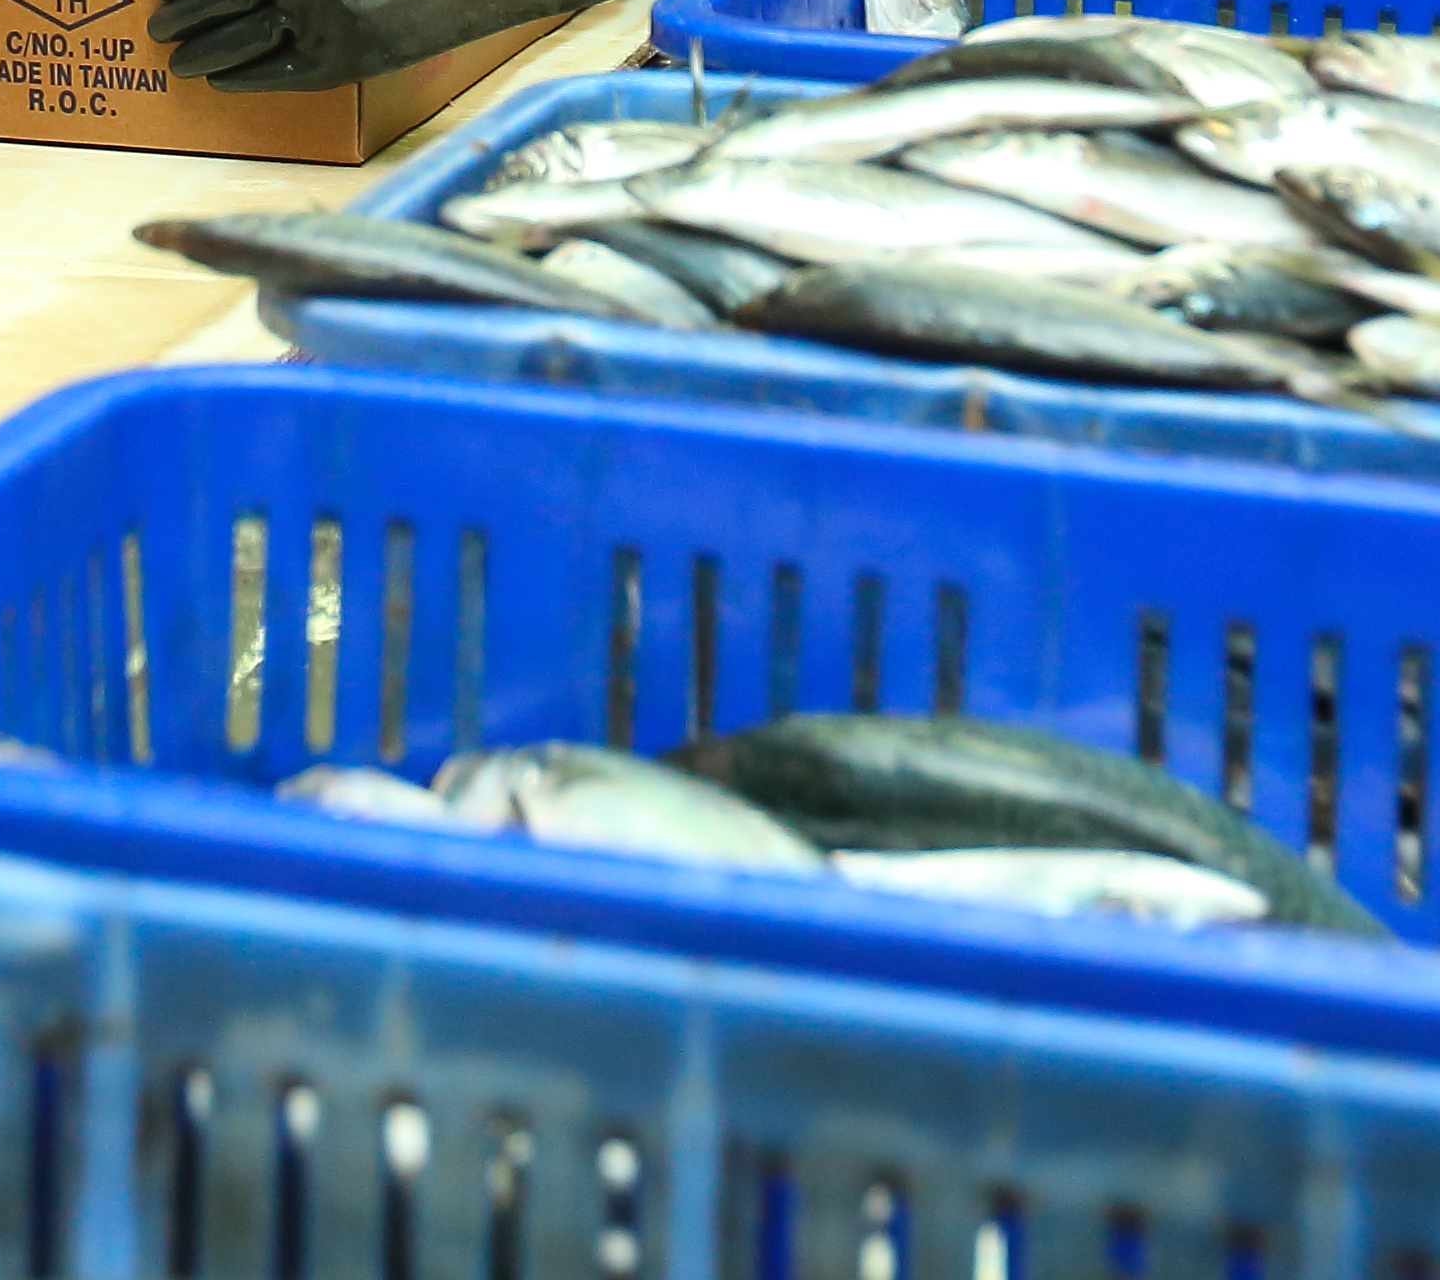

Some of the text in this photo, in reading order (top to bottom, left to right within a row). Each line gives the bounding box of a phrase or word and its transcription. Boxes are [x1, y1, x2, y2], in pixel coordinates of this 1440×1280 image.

[5, 30, 135, 62] C/NO. 1-UP
[49, 62, 73, 87] IN
[78, 64, 168, 93] TAIWAN
[28, 90, 117, 117] R.O.C.
